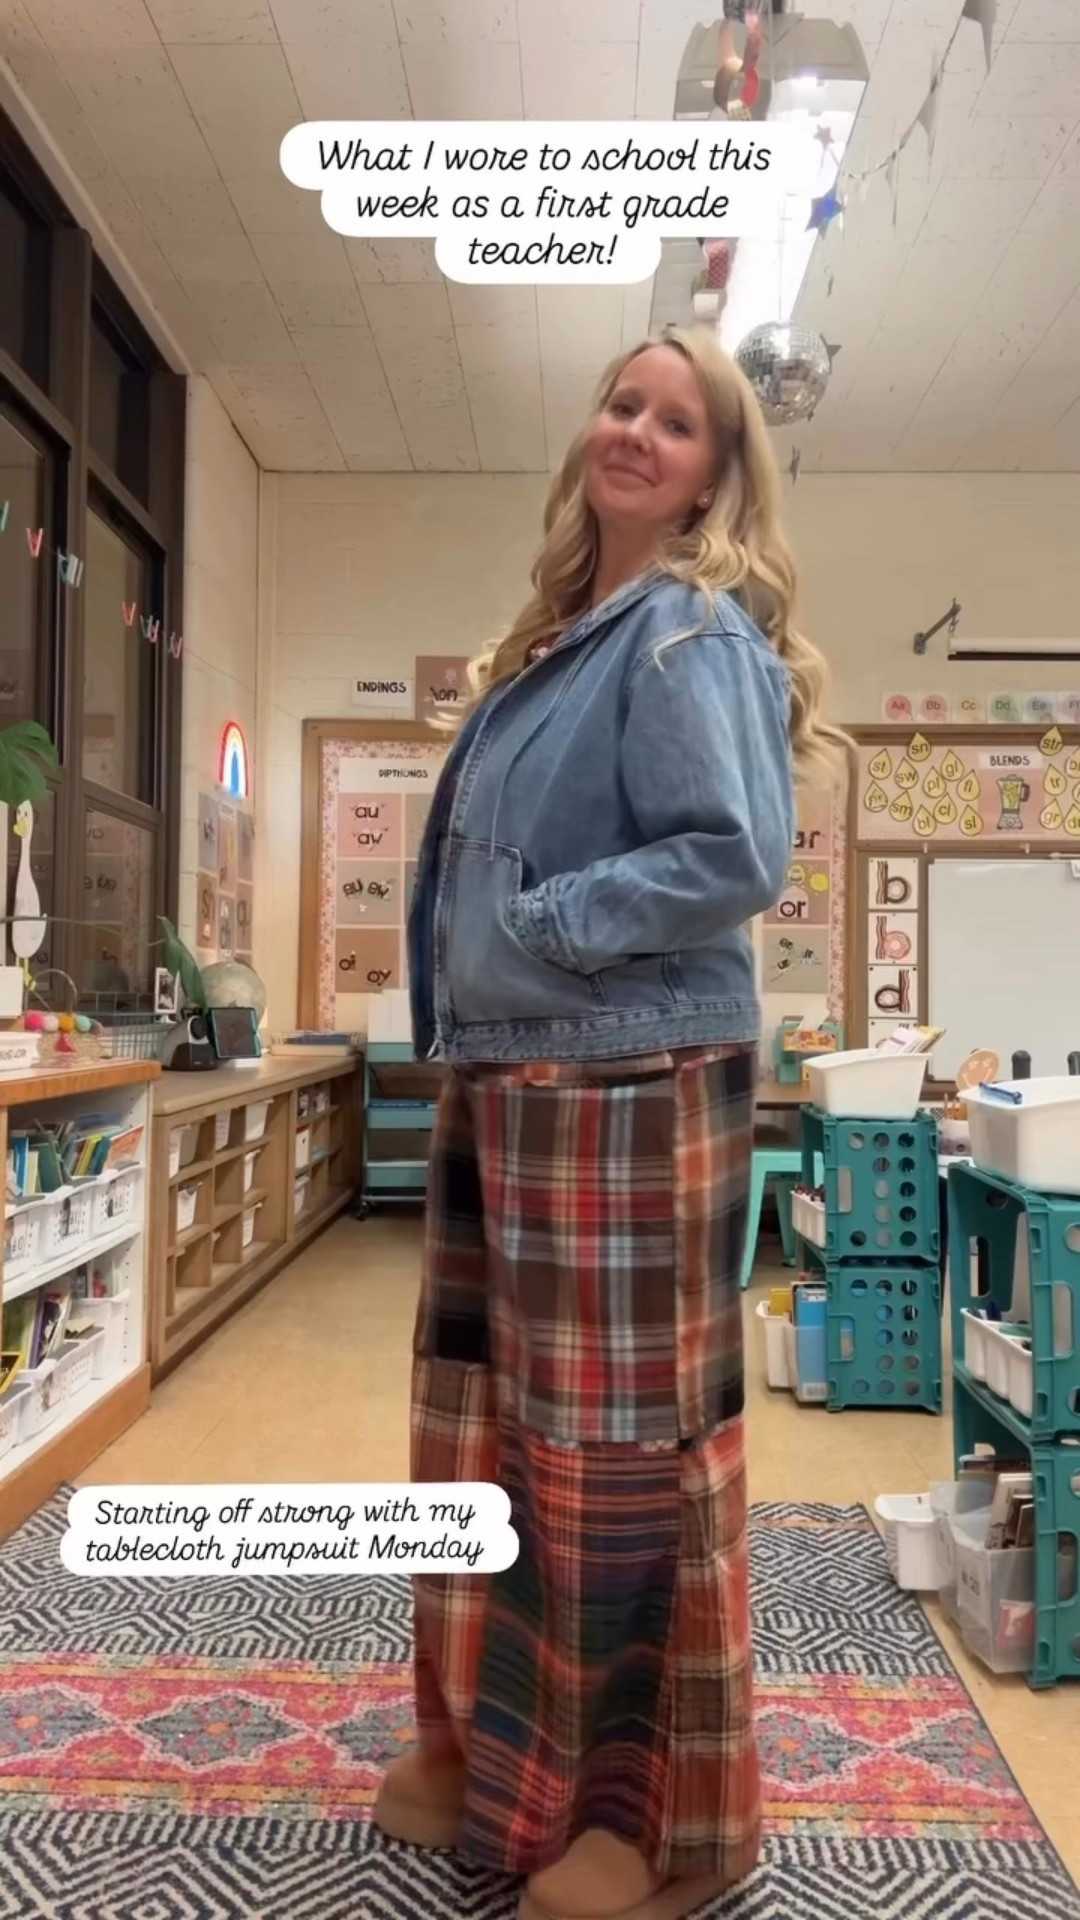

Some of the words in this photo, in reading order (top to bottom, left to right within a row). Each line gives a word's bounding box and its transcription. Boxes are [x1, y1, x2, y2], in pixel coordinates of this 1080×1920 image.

[356, 681, 407, 694] ENDINGS
[926, 700, 942, 711] Bb
[961, 700, 976, 711] Cc
[911, 743, 929, 755] sn
[990, 755, 1031, 766] BLENDS
[945, 760, 958, 778] gl
[927, 777, 940, 792] pl
[355, 806, 380, 819] au
[939, 803, 951, 817] cl
[917, 816, 931, 830] bl
[964, 815, 977, 830] sl
[357, 832, 383, 846] aw
[779, 901, 806, 918] or
[367, 969, 392, 987] oy
